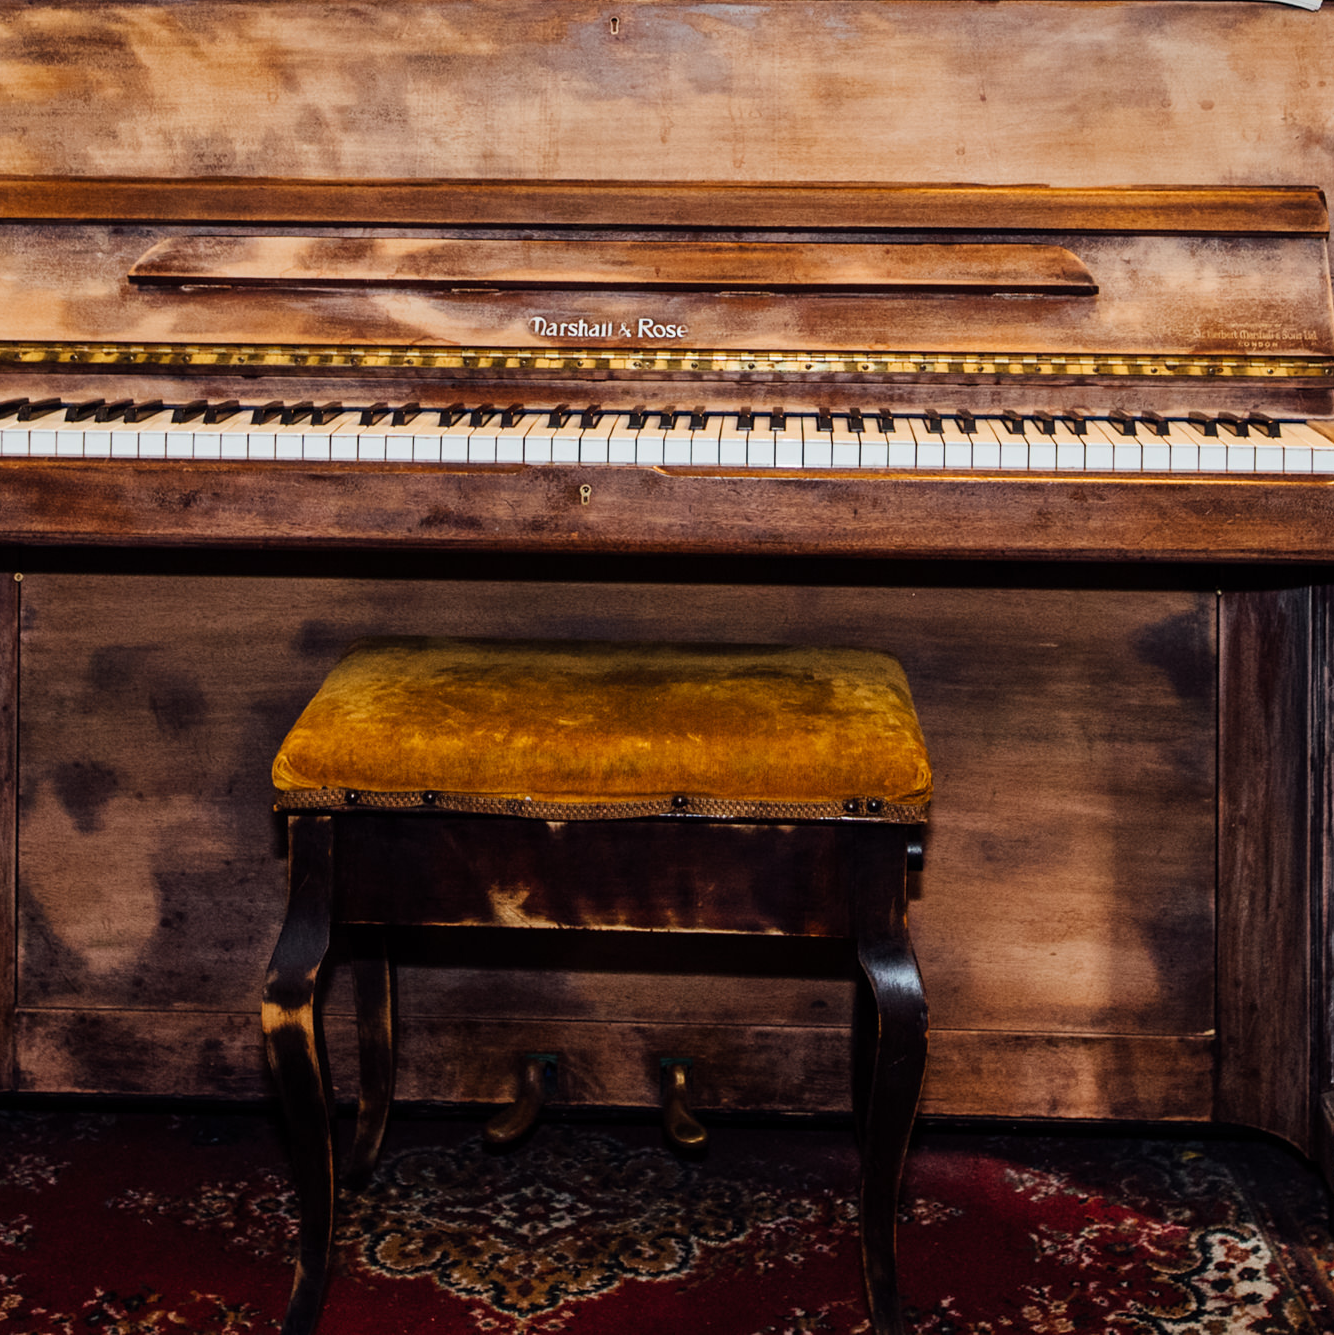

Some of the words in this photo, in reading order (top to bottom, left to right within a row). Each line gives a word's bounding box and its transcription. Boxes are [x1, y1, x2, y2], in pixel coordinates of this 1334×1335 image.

[528, 316, 612, 338] Marshall
[619, 322, 632, 338] &
[638, 318, 689, 338] Rose
